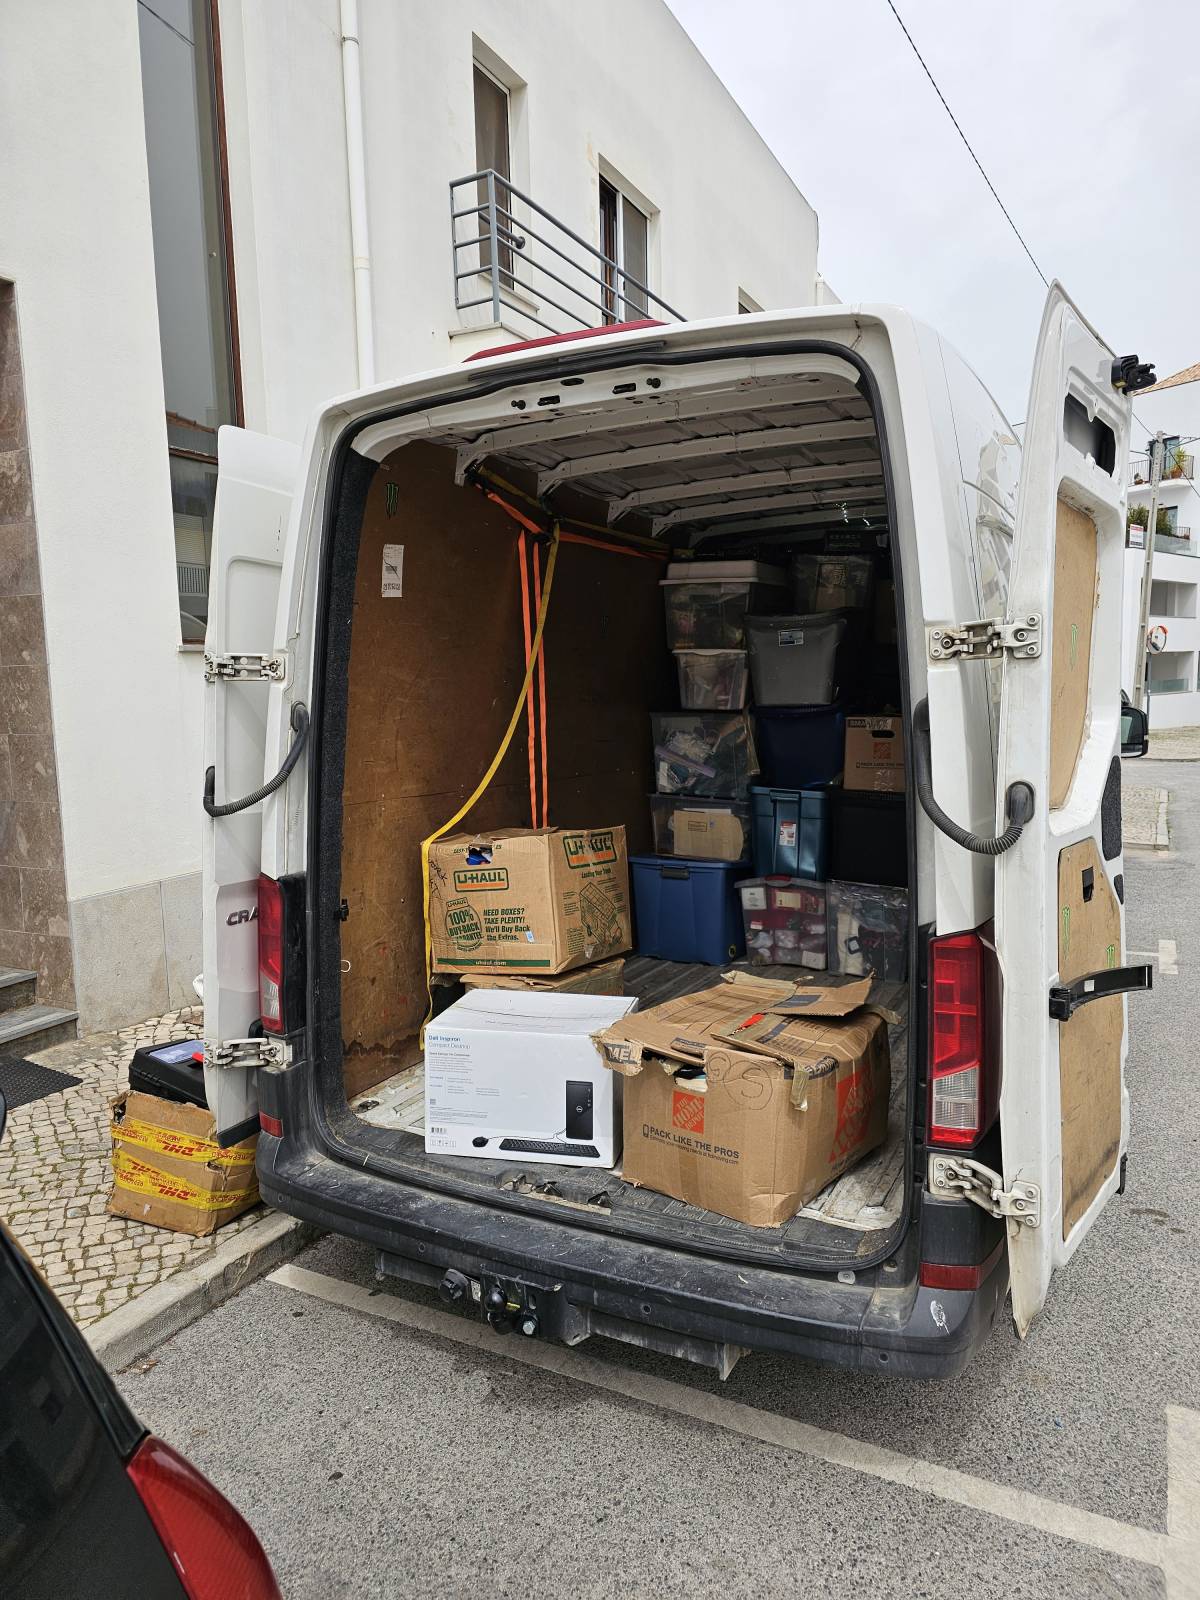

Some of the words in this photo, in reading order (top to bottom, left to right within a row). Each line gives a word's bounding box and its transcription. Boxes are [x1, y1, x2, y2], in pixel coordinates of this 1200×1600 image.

[456, 871, 505, 883] U-HAUL
[448, 909, 474, 926] 100%
[483, 908, 499, 916] NEED
[500, 907, 525, 916] BOXES?
[483, 917, 499, 925] TAKE
[501, 925, 513, 933] Buy
[514, 924, 531, 932] Back
[161, 1141, 195, 1157] DHL
[650, 1126, 671, 1140] PACK
[673, 1134, 692, 1146] LIKE
[694, 1140, 712, 1152] THE
[714, 1145, 740, 1159] PROS
[158, 1184, 191, 1201] DHL
